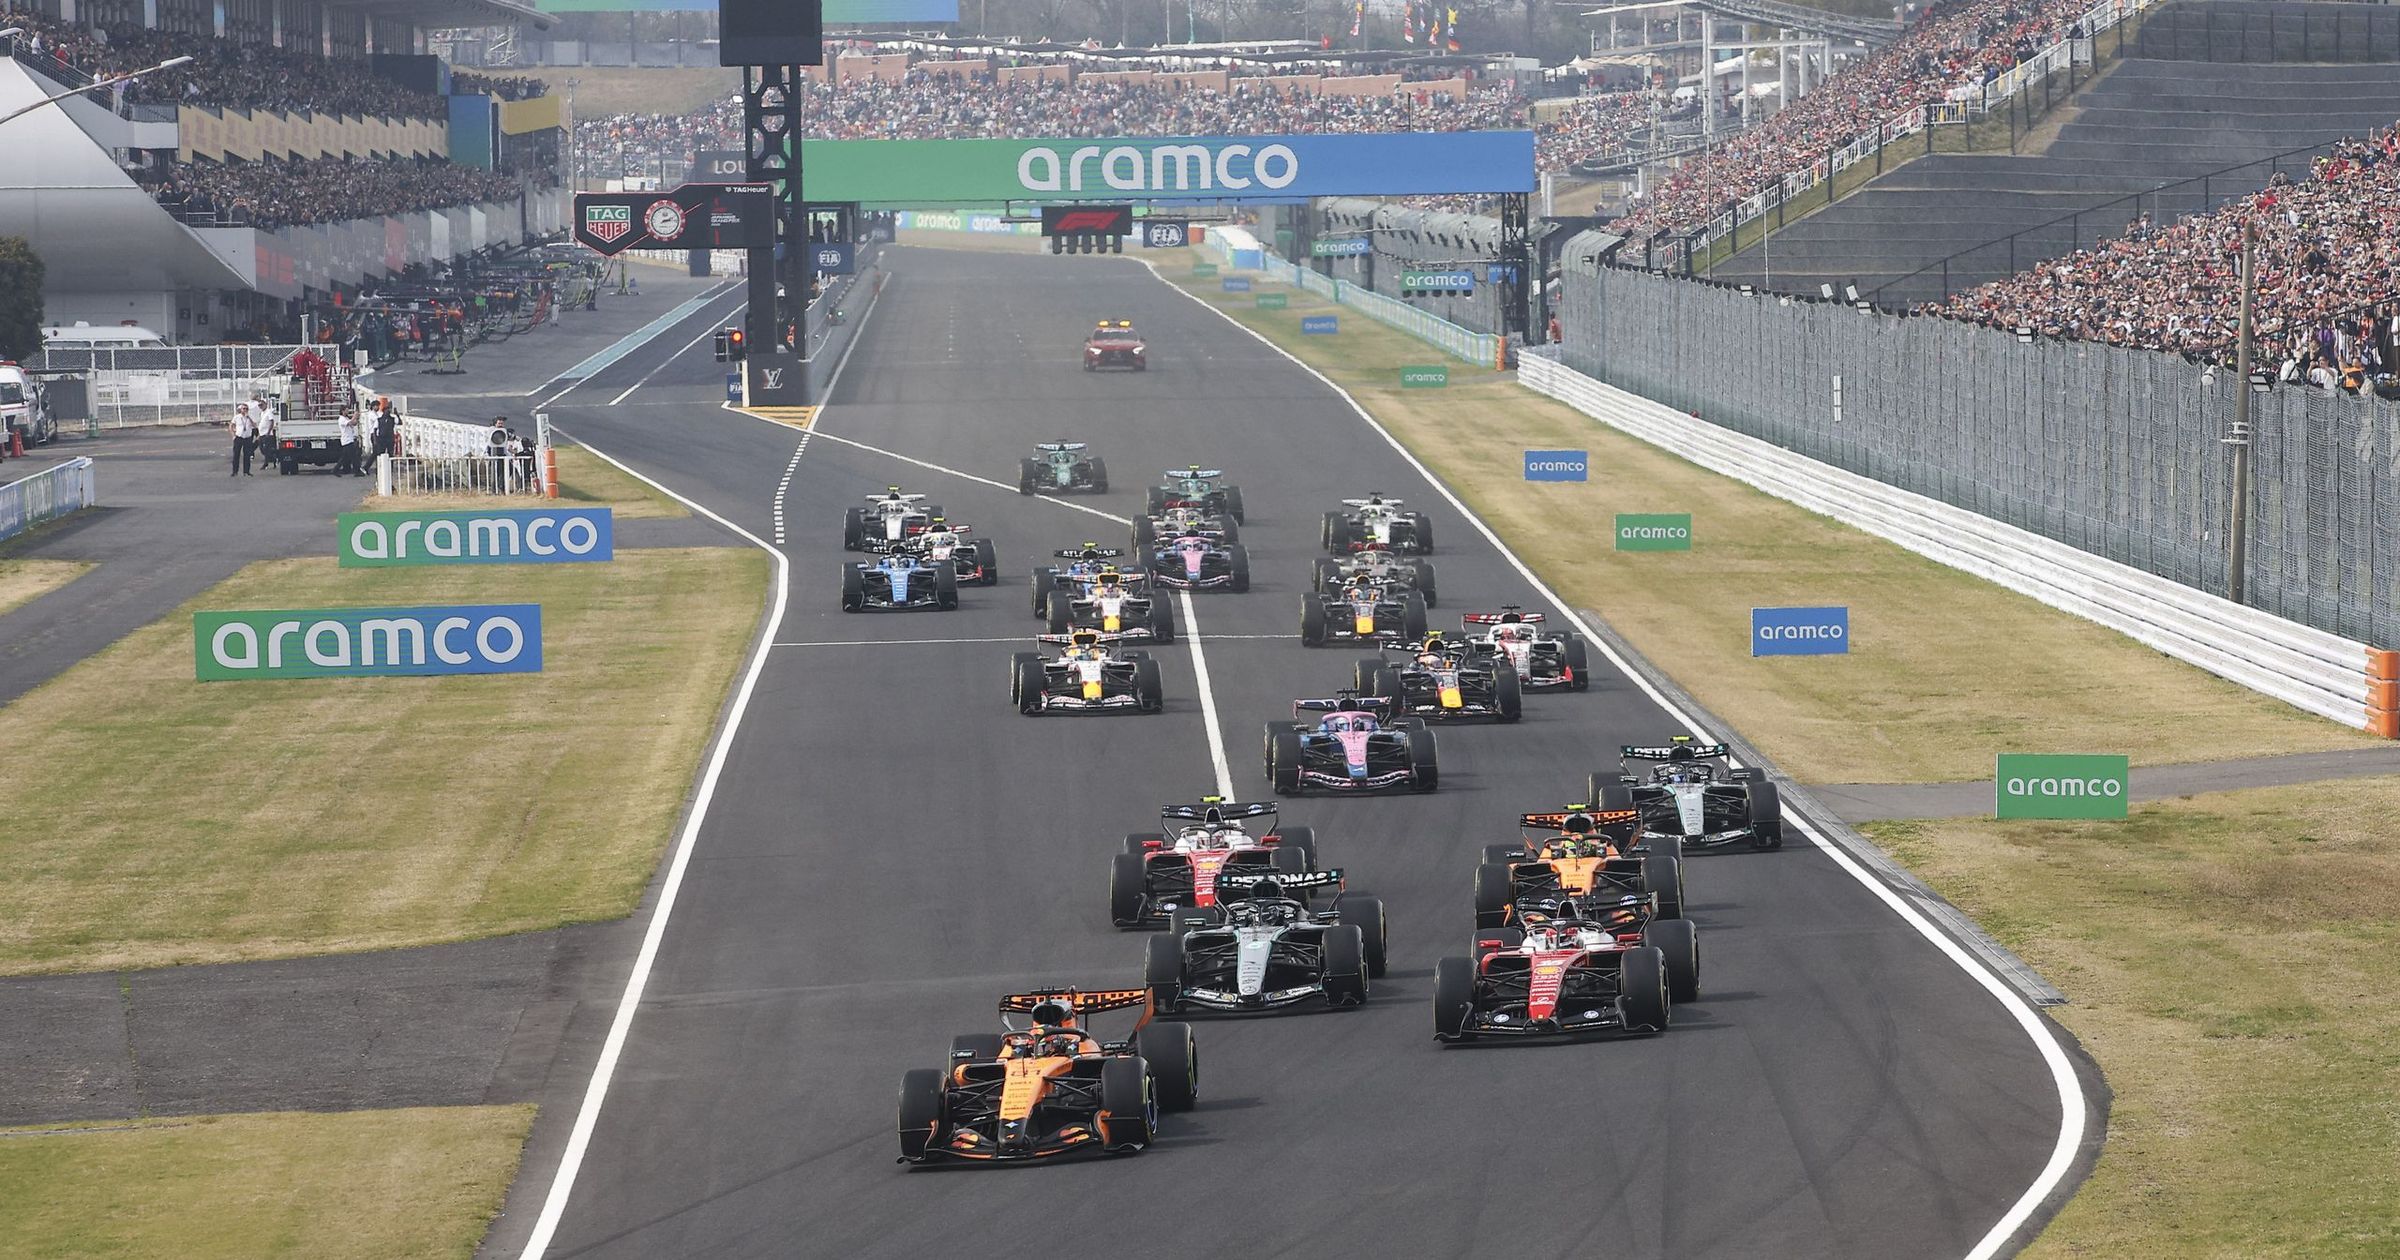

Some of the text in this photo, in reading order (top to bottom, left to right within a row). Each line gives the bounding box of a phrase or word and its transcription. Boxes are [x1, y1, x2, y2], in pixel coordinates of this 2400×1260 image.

[715, 160, 746, 174] LOU
[1018, 144, 1298, 191] aramco
[590, 208, 626, 219] TAG
[590, 223, 628, 240] HEUER
[1153, 229, 1180, 242] FIA
[1316, 243, 1366, 253] aramco
[819, 253, 840, 264] FIA
[1406, 275, 1469, 287] aramco
[1405, 373, 1446, 382] aramco
[1529, 461, 1585, 473] aramco
[351, 516, 598, 559] aramco
[1621, 526, 1687, 539] aramco
[1760, 624, 1844, 640] aramco
[212, 615, 525, 669] aramco
[2007, 777, 2122, 797] aramco
